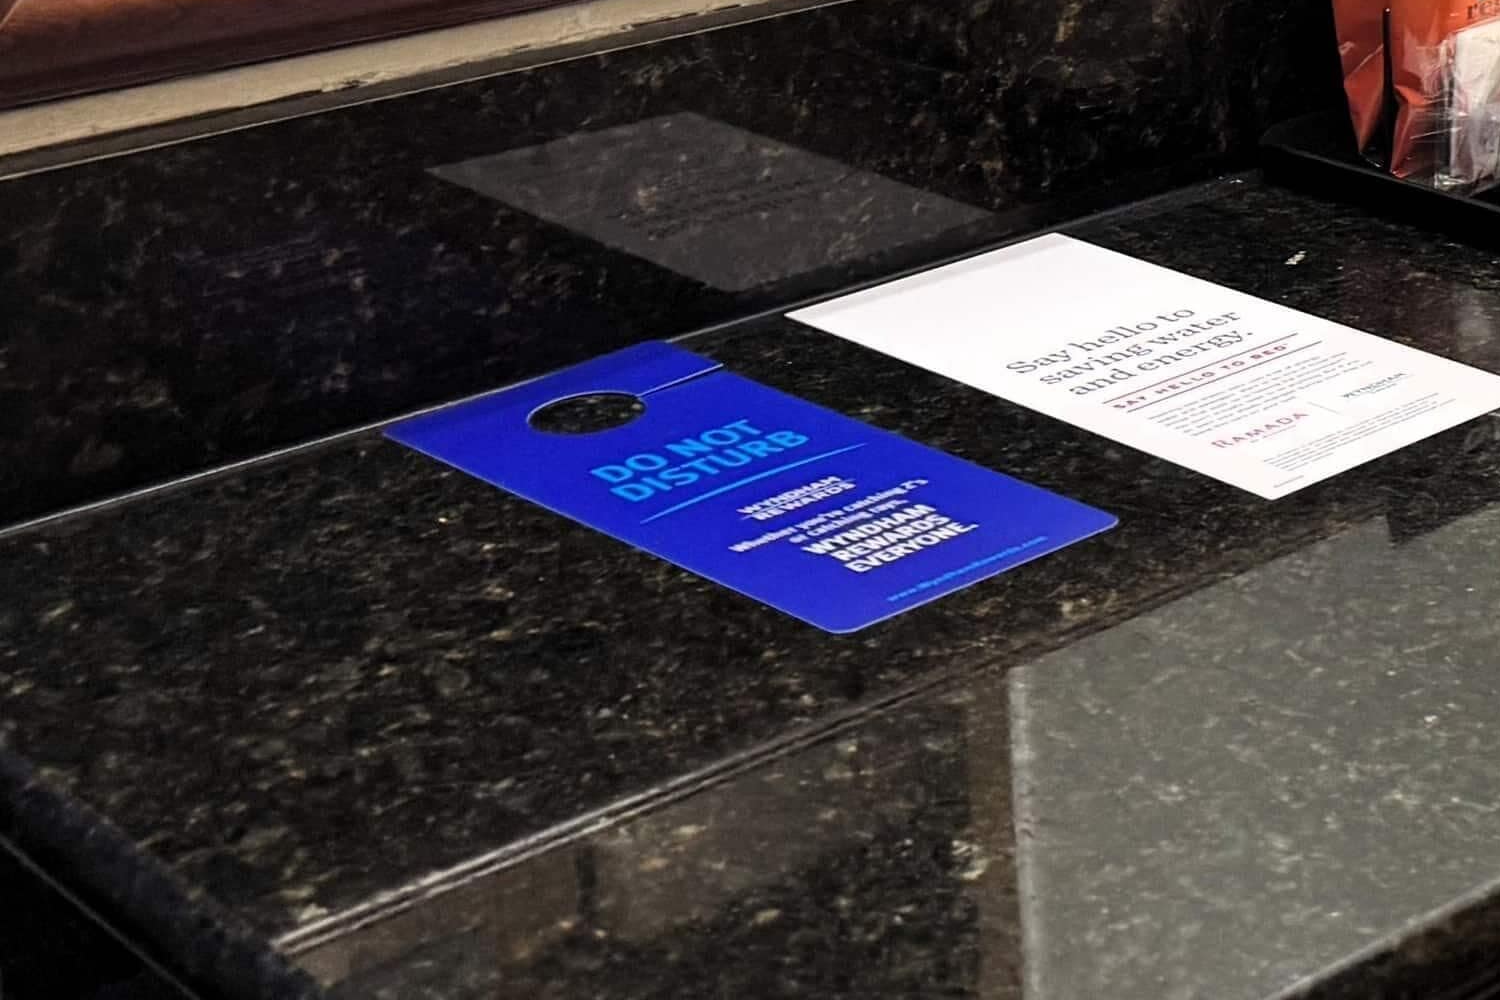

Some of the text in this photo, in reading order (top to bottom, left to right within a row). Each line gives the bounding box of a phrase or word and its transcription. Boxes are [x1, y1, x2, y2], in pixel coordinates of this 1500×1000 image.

[1006, 308, 1195, 374] Say hello to
[1039, 311, 1241, 385] saving water
[1068, 367, 1138, 396] and
[1136, 329, 1254, 371] energy.
[1112, 395, 1147, 409] SAY
[1154, 371, 1216, 394] HELLO
[1220, 360, 1247, 371] TO
[589, 418, 762, 483] DO NOT
[1211, 411, 1309, 449] RAMADA
[610, 430, 810, 502] DISTURB
[728, 525, 799, 553] Whether
[797, 508, 844, 531] you're
[843, 487, 904, 513] catching
[736, 475, 841, 514] WYNDHAM
[752, 481, 857, 521] REWARDS
[788, 533, 808, 544] or
[806, 511, 873, 538] catching
[802, 504, 937, 556] WYNDHAM
[829, 516, 952, 562] REWARDS
[844, 523, 979, 573] EVERYONE.
